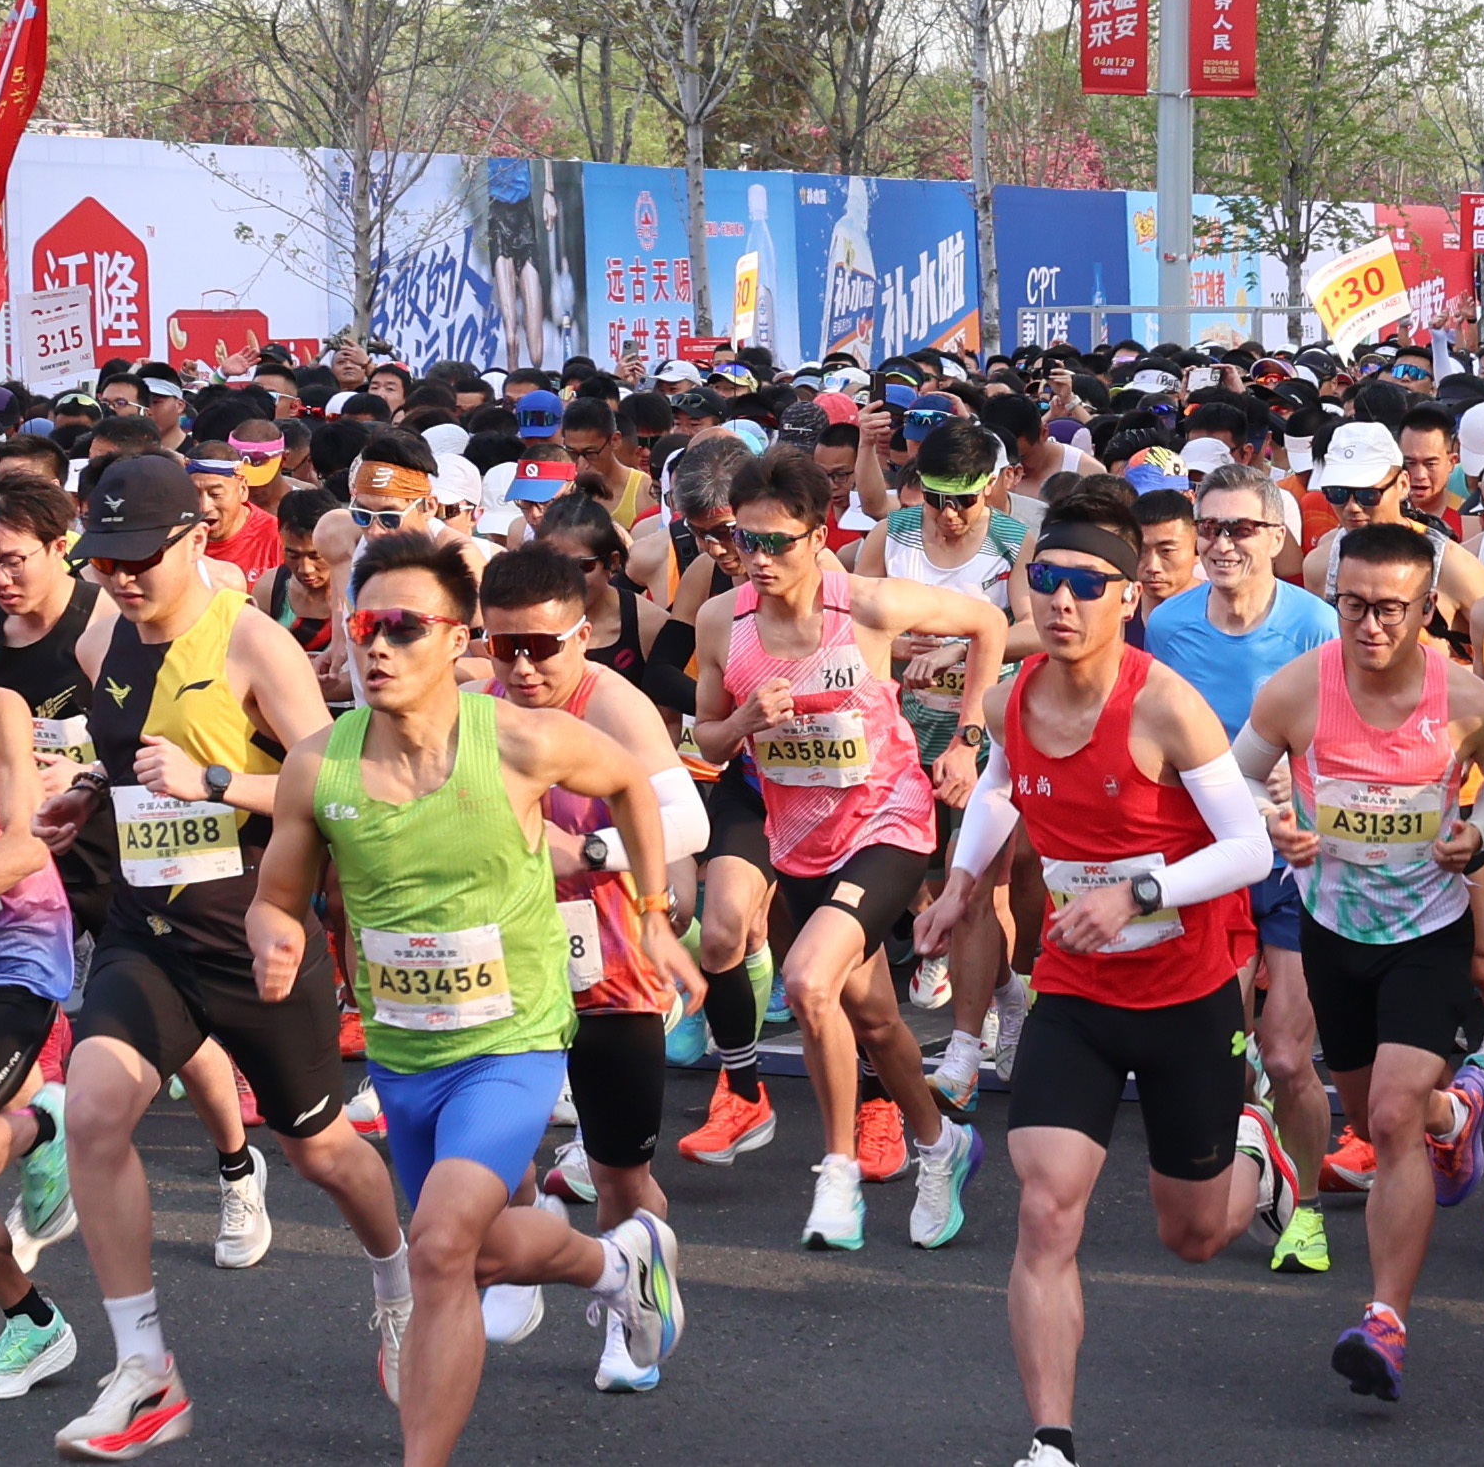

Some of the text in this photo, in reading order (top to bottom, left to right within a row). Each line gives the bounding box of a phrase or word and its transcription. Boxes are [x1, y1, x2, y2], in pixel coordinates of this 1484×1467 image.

[880, 230, 966, 360] 补水啦
[1026, 265, 1062, 308] CPT
[1320, 266, 1385, 328] 1:30
[36, 325, 84, 358] 3:15
[767, 739, 857, 761] A35840
[1350, 794, 1408, 805] 中国人民保险
[1366, 784, 1392, 796] PICC
[126, 816, 221, 850] A32188
[1332, 810, 1423, 835] A31331
[1083, 865, 1109, 876] PICC
[408, 936, 438, 948] PICC
[379, 963, 493, 995] A33456
